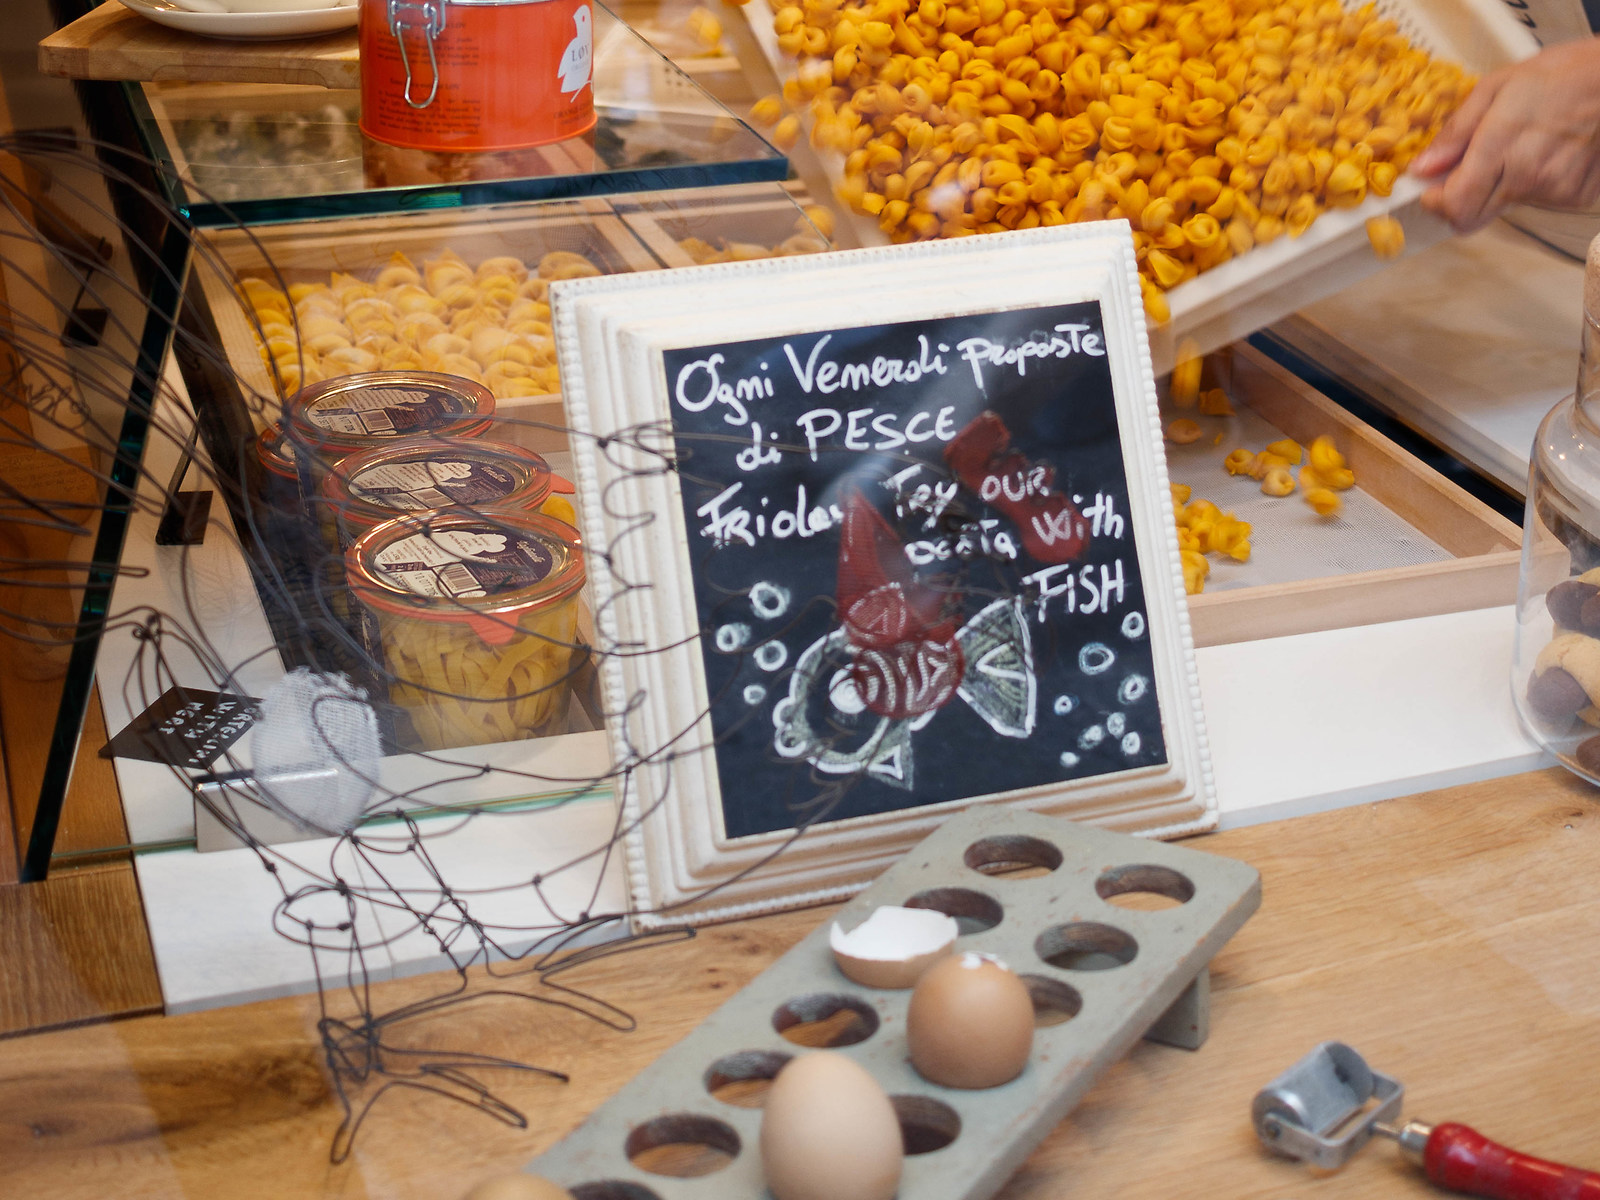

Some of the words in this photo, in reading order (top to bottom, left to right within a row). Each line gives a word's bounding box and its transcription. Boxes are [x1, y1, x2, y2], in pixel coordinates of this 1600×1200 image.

[675, 352, 774, 426] Ogni
[783, 333, 951, 394] Venerdi
[736, 421, 782, 471] di
[796, 405, 957, 462] PESCE
[1021, 558, 1125, 623] FISH
